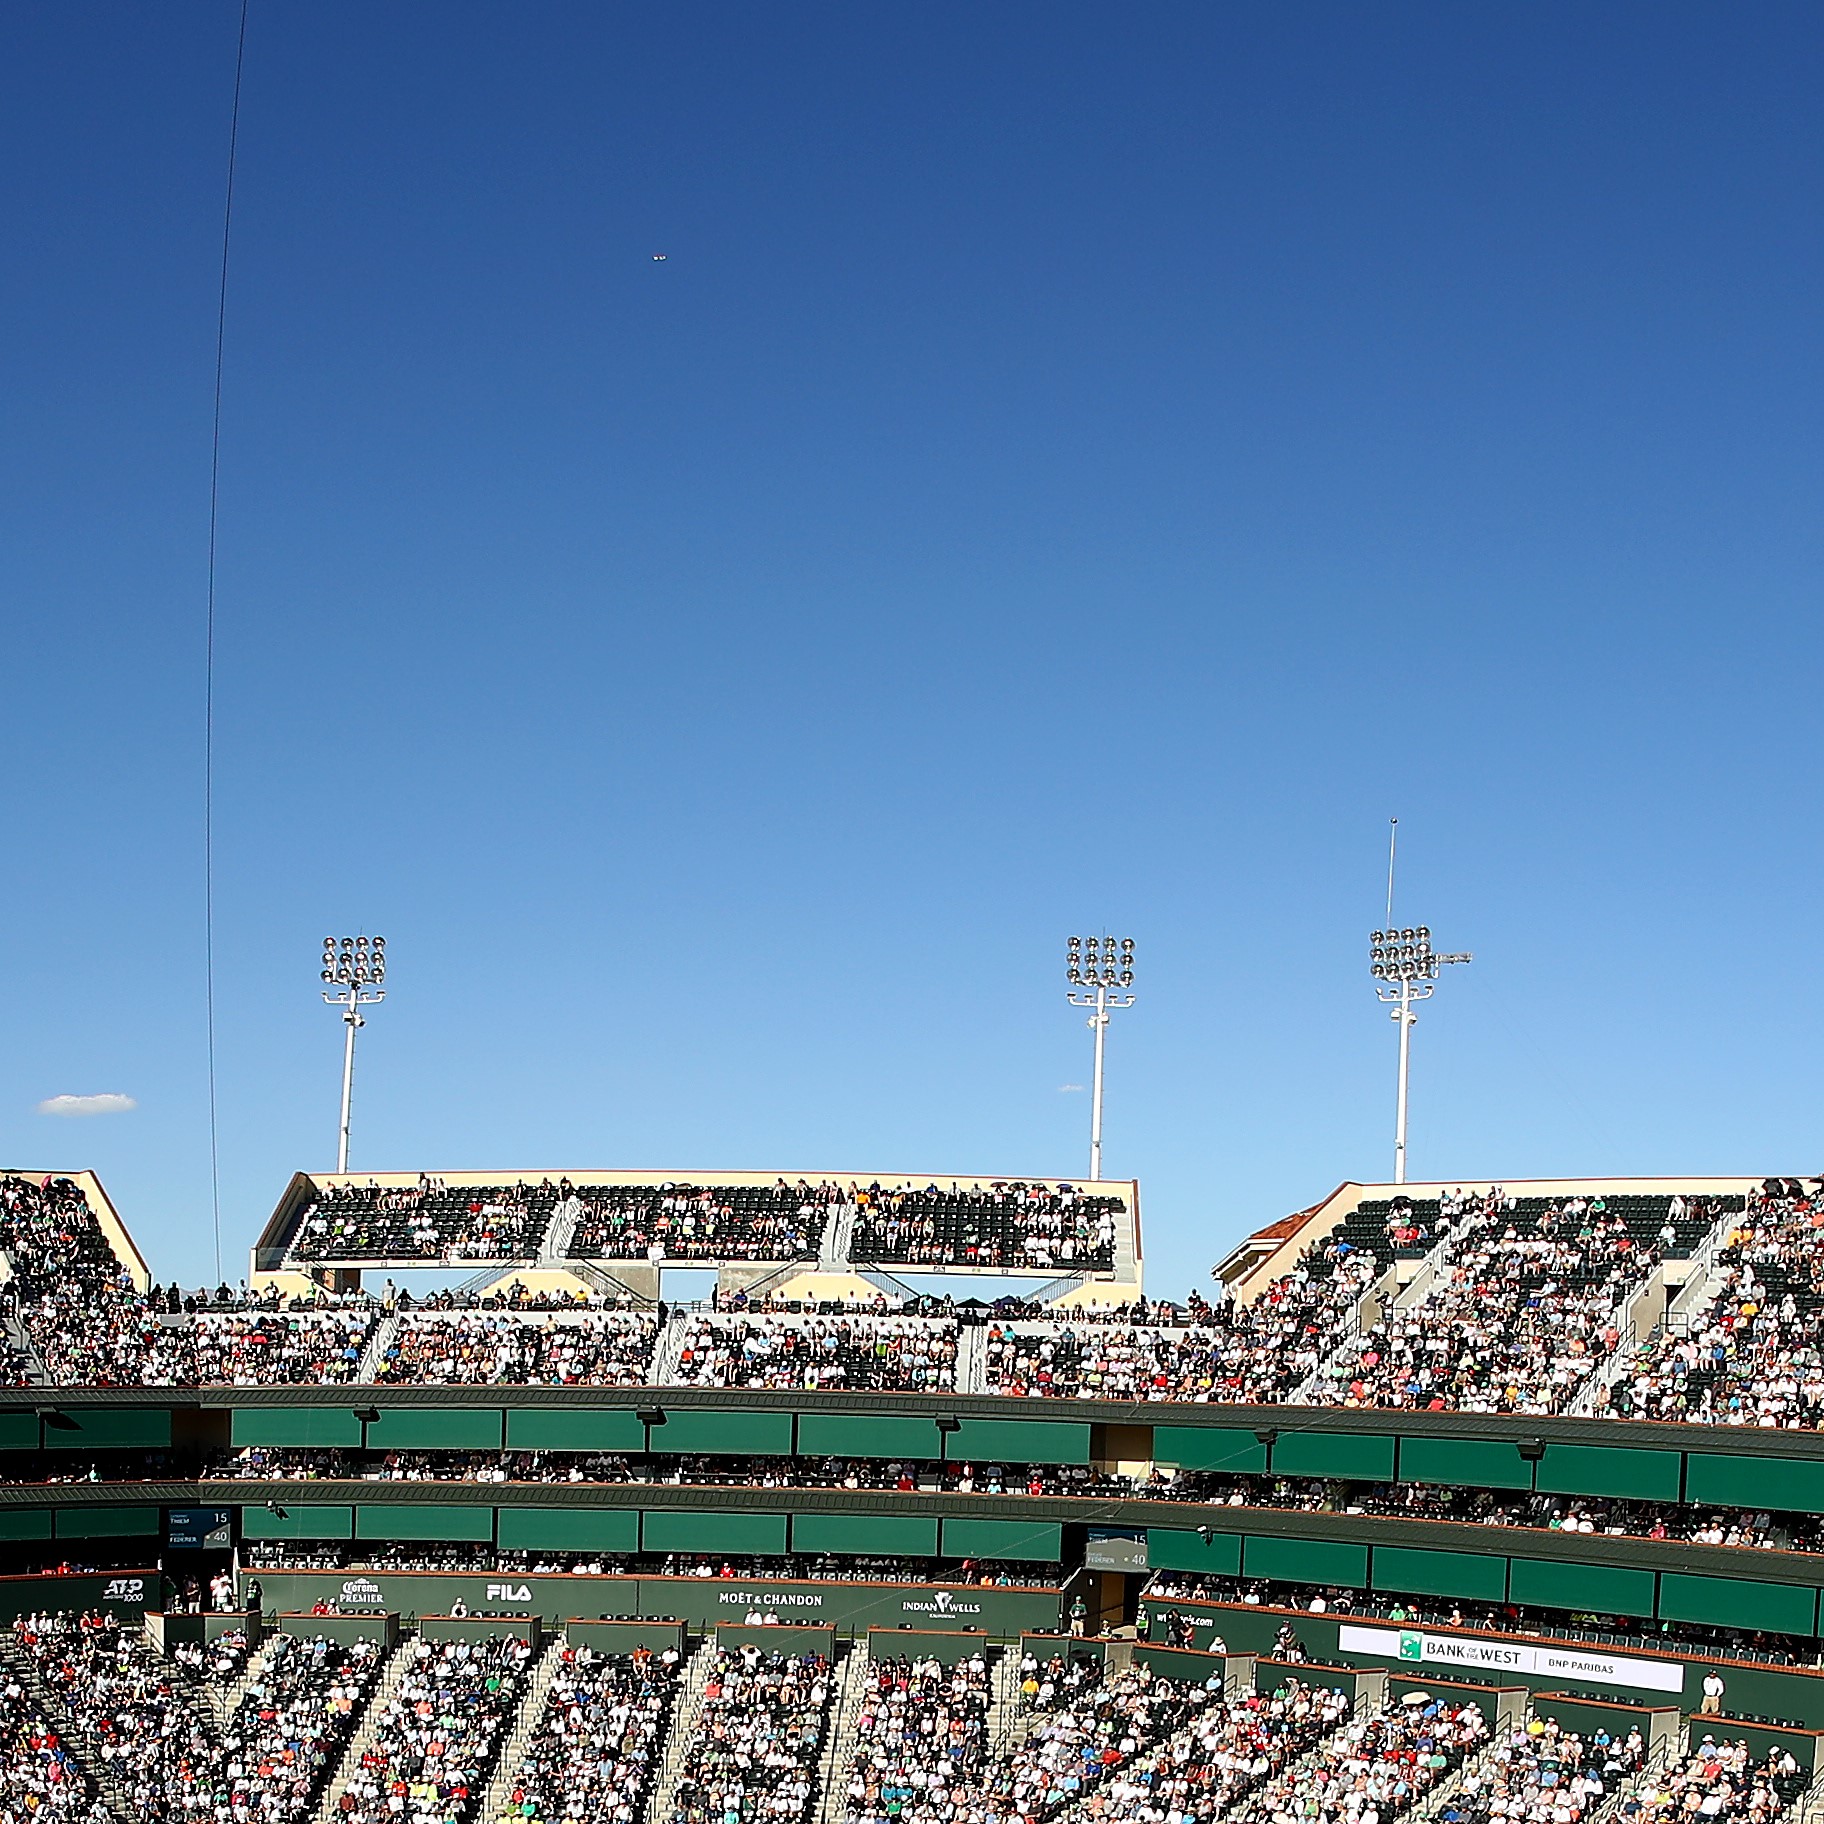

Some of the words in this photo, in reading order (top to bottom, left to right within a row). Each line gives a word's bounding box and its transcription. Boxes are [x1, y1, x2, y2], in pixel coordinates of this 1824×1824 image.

[214, 1512, 228, 1524] 15
[213, 1531, 227, 1542] 40
[1133, 1534, 1146, 1546] 15
[1131, 1554, 1146, 1566] 40
[103, 1579, 144, 1595] ATP
[342, 1580, 379, 1594] Corona
[486, 1584, 532, 1601] FILA
[339, 1593, 384, 1604] PREMIER
[763, 1594, 823, 1606] CHANDON
[902, 1601, 938, 1612] INDIAN
[949, 1603, 981, 1613] WELLS
[1426, 1641, 1465, 1658] BANK
[1479, 1648, 1521, 1665] WEST
[1548, 1658, 1569, 1669] BNP
[1570, 1660, 1614, 1675] PARIBAS
